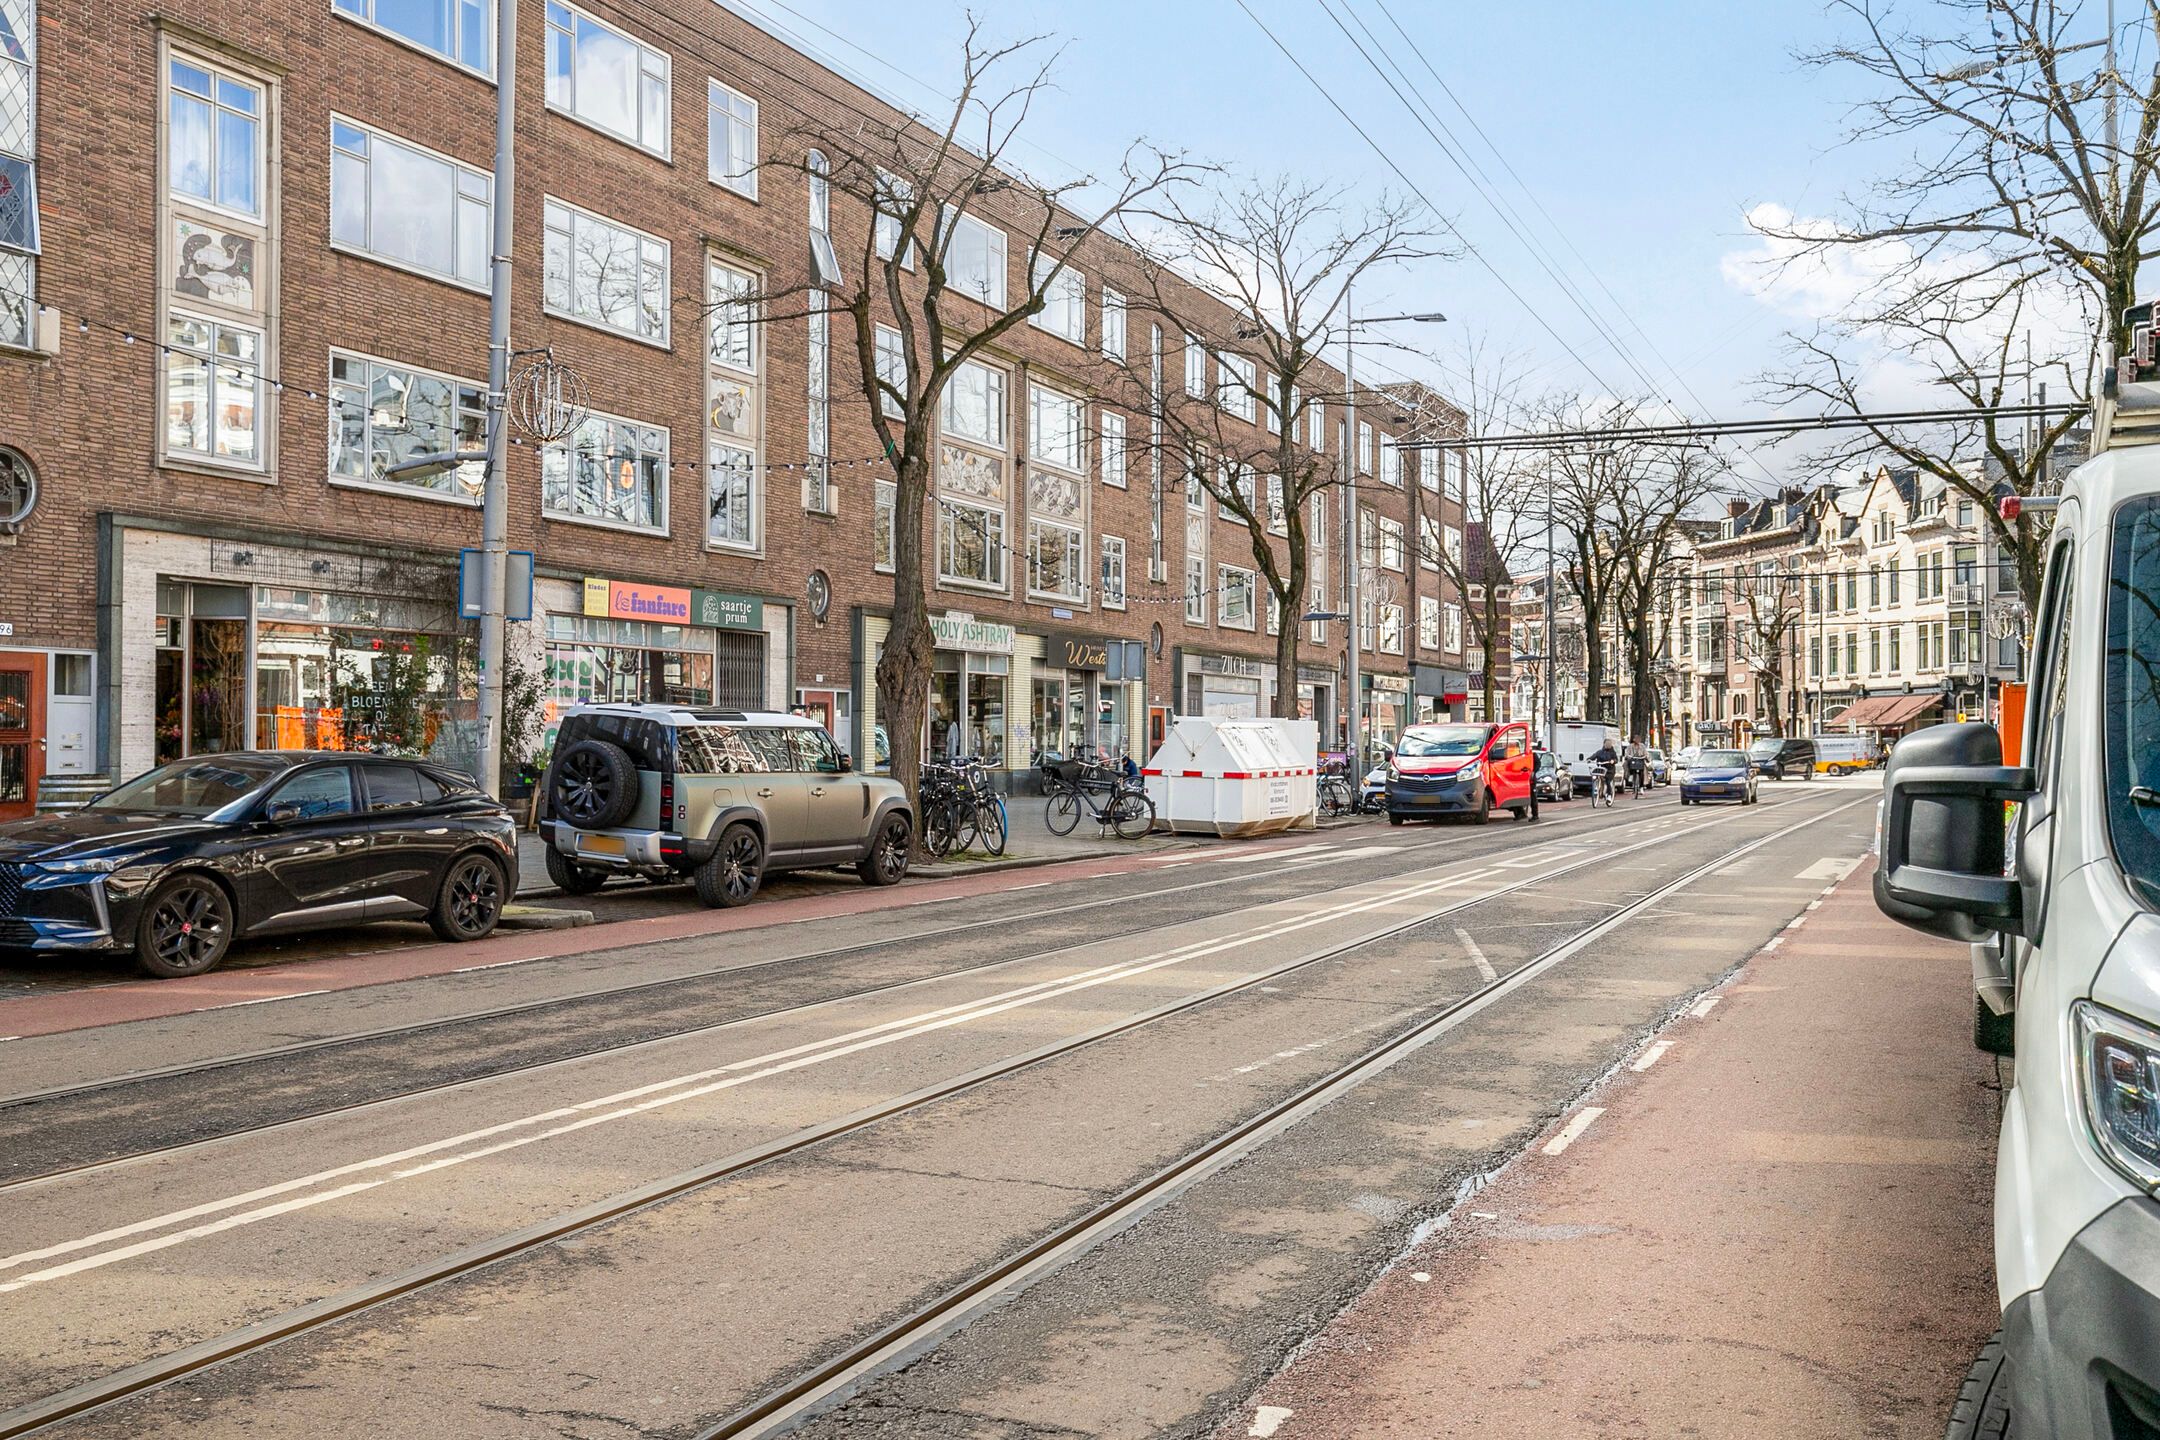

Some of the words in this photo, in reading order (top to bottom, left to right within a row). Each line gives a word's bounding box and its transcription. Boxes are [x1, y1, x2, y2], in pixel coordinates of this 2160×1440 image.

[615, 590, 630, 612] le
[631, 592, 687, 617] fanfare
[720, 600, 752, 615] saartje
[725, 613, 748, 625] prum
[931, 619, 960, 639] HOLY
[962, 623, 1010, 644] ASHTRAY
[1221, 655, 1247, 676] ZILCH
